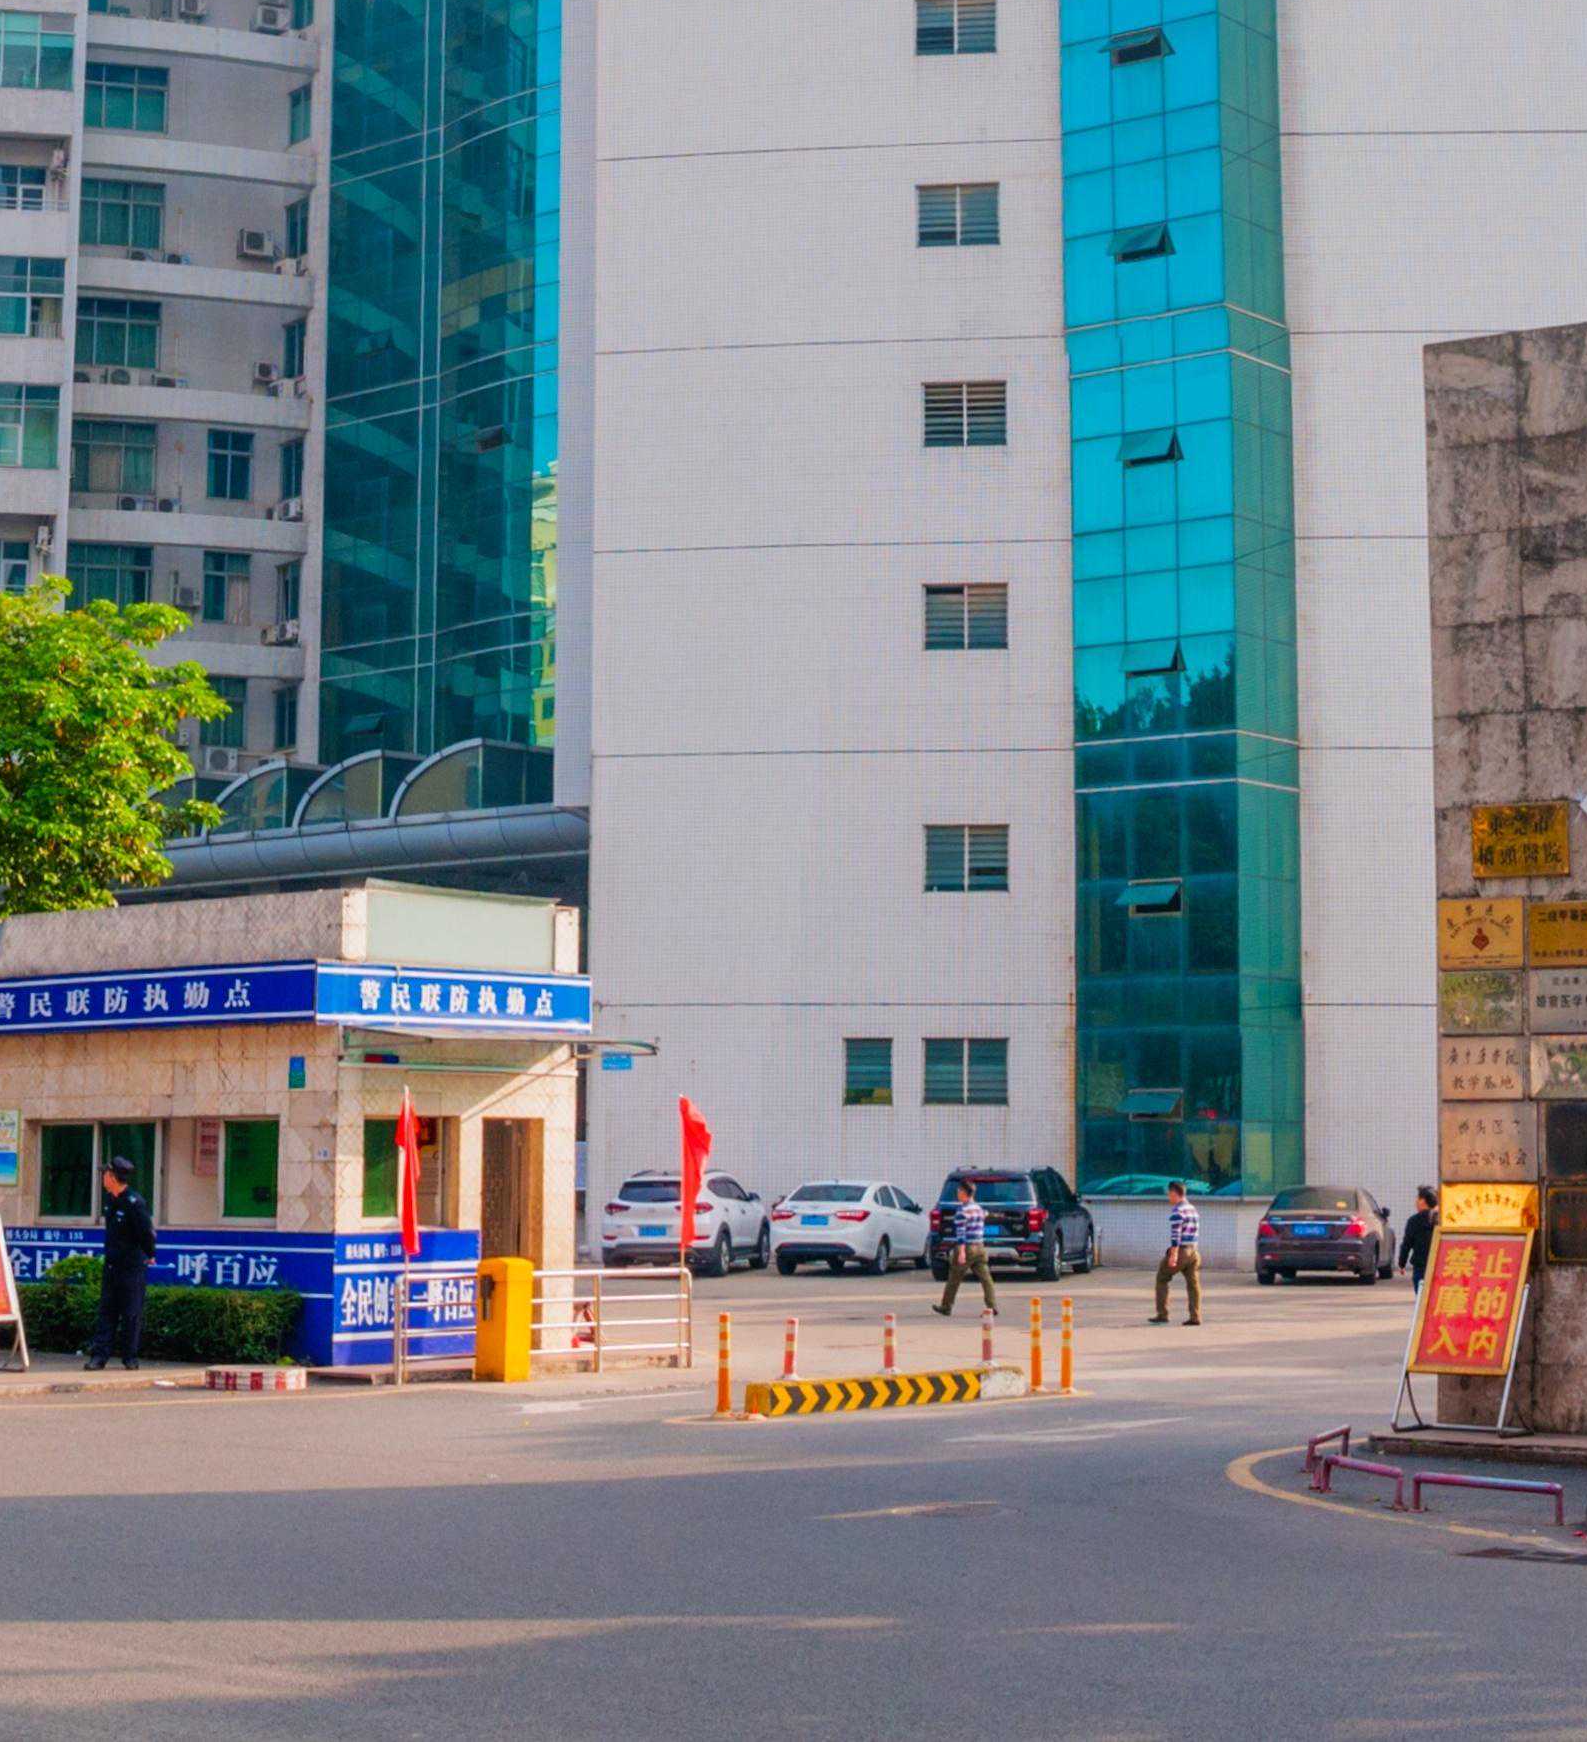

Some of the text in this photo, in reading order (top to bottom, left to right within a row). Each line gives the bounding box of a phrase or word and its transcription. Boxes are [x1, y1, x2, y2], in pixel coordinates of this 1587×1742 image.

[359, 979, 555, 1018] 警民联防执勤点
[1440, 1246, 1513, 1280] 禁止
[1425, 1324, 1499, 1360] 入内
